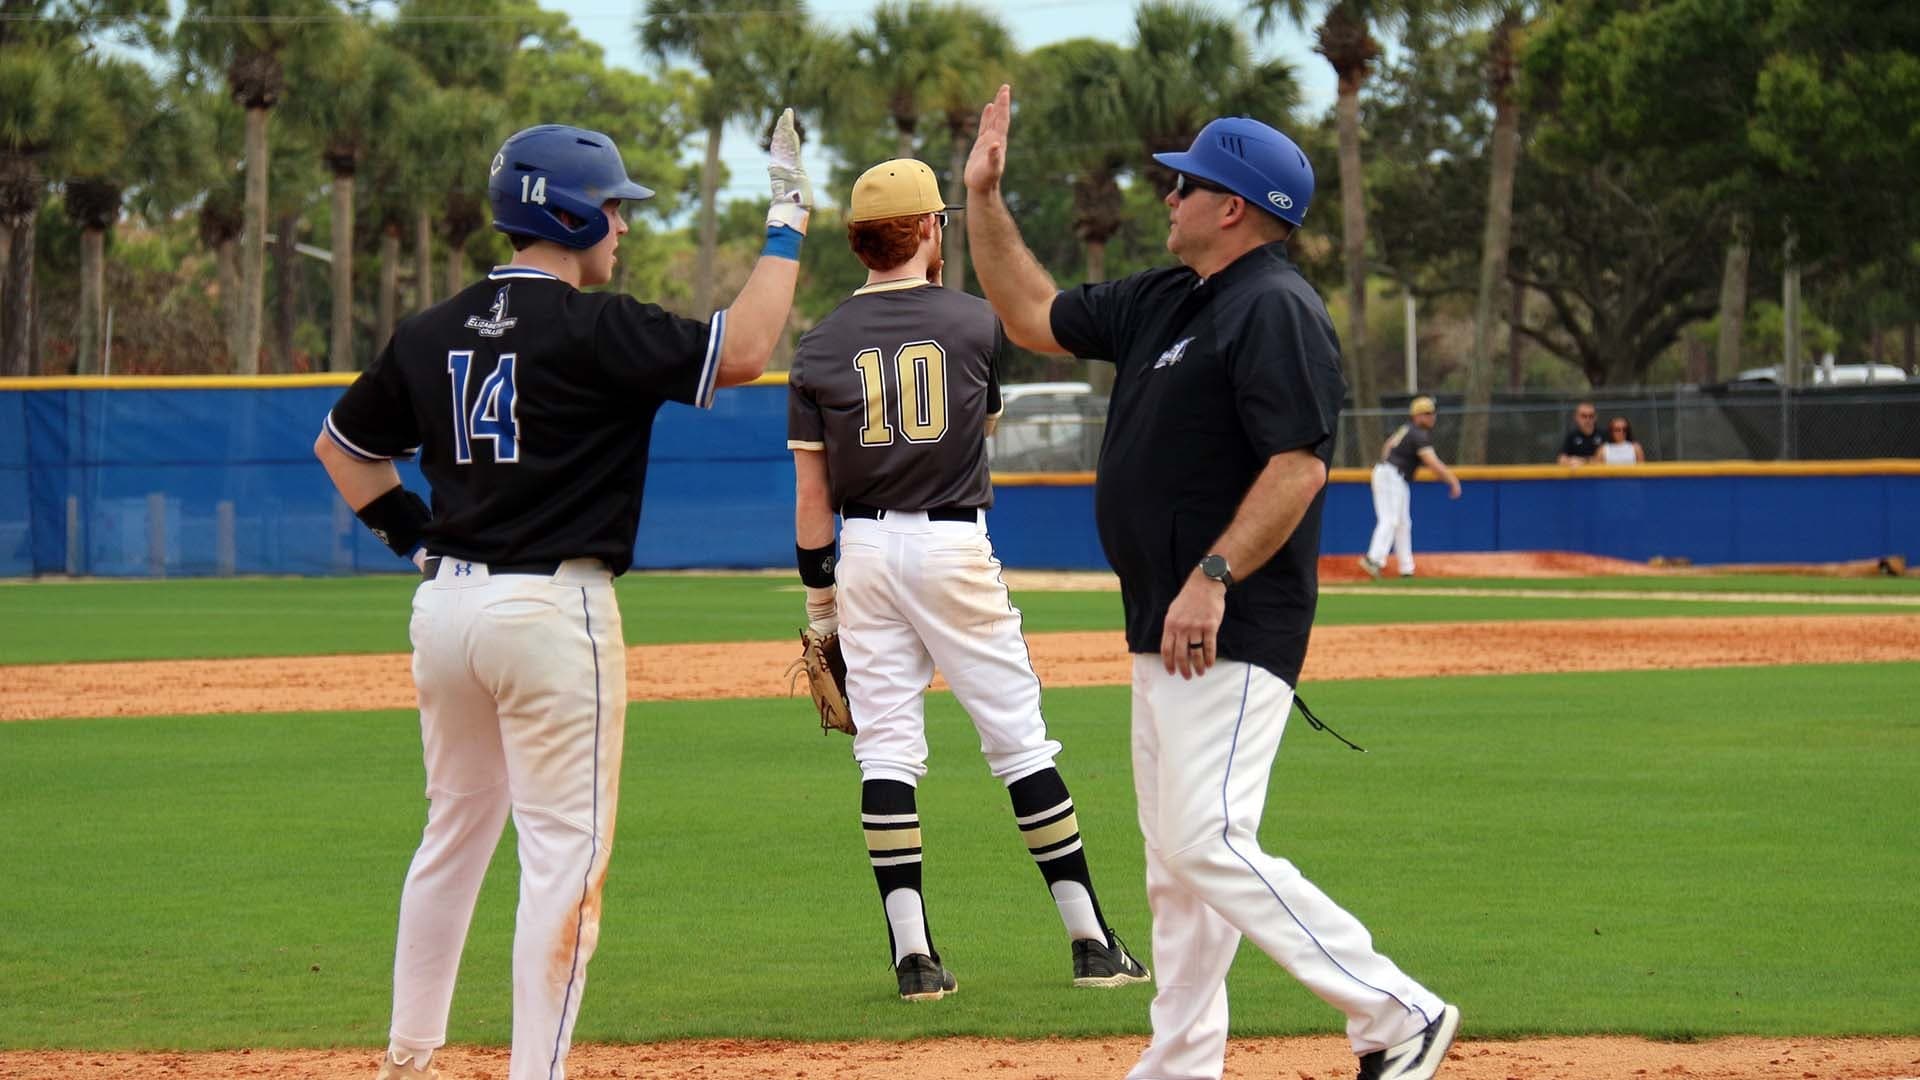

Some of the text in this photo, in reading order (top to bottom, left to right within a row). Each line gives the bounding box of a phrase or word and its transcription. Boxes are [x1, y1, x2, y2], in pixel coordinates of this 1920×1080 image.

[521, 175, 546, 205] 14
[448, 350, 520, 464] 14
[853, 340, 948, 447] 10
